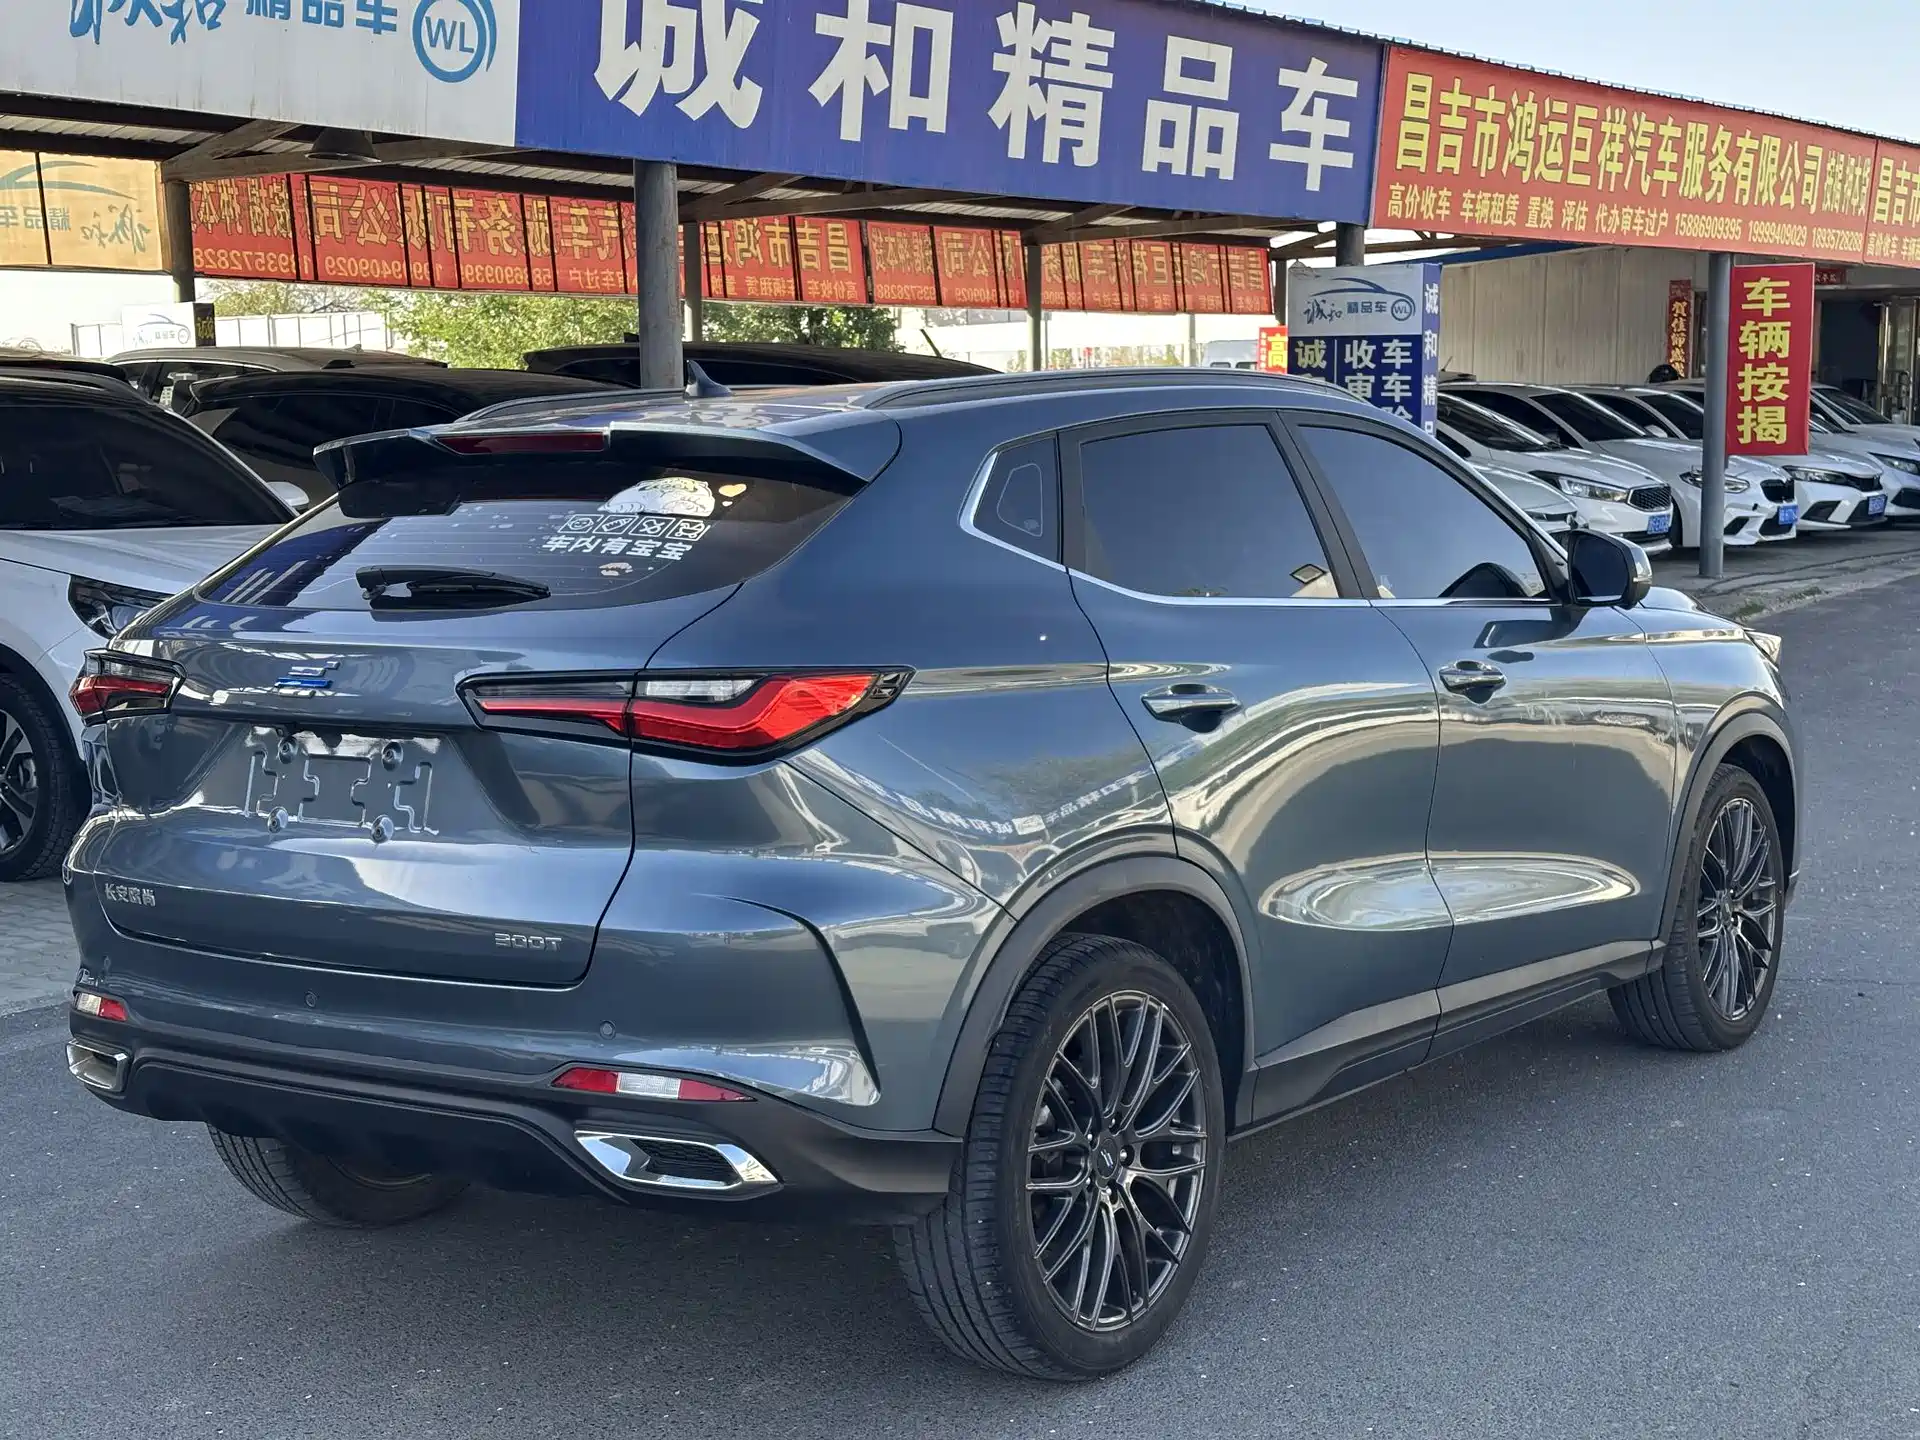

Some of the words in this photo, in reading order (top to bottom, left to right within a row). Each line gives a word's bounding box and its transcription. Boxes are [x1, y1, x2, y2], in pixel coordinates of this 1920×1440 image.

[424, 15, 475, 54] WL
[594, 0, 1358, 191] 诚和精品车
[1396, 72, 1823, 215] 昌吉市鸿运巨祥汽车服务有限公司
[1388, 182, 1452, 222] 高价收车
[1460, 189, 1519, 227] 车辆租赁
[1525, 196, 1554, 229] 置换
[1561, 199, 1589, 232] 评估
[1595, 202, 1669, 237] 代办审车过户
[1675, 212, 1743, 241] 15886909395
[1737, 276, 1792, 445] 车辆按揭
[542, 535, 693, 561] 车内有宝宝
[494, 932, 562, 952] 300T
